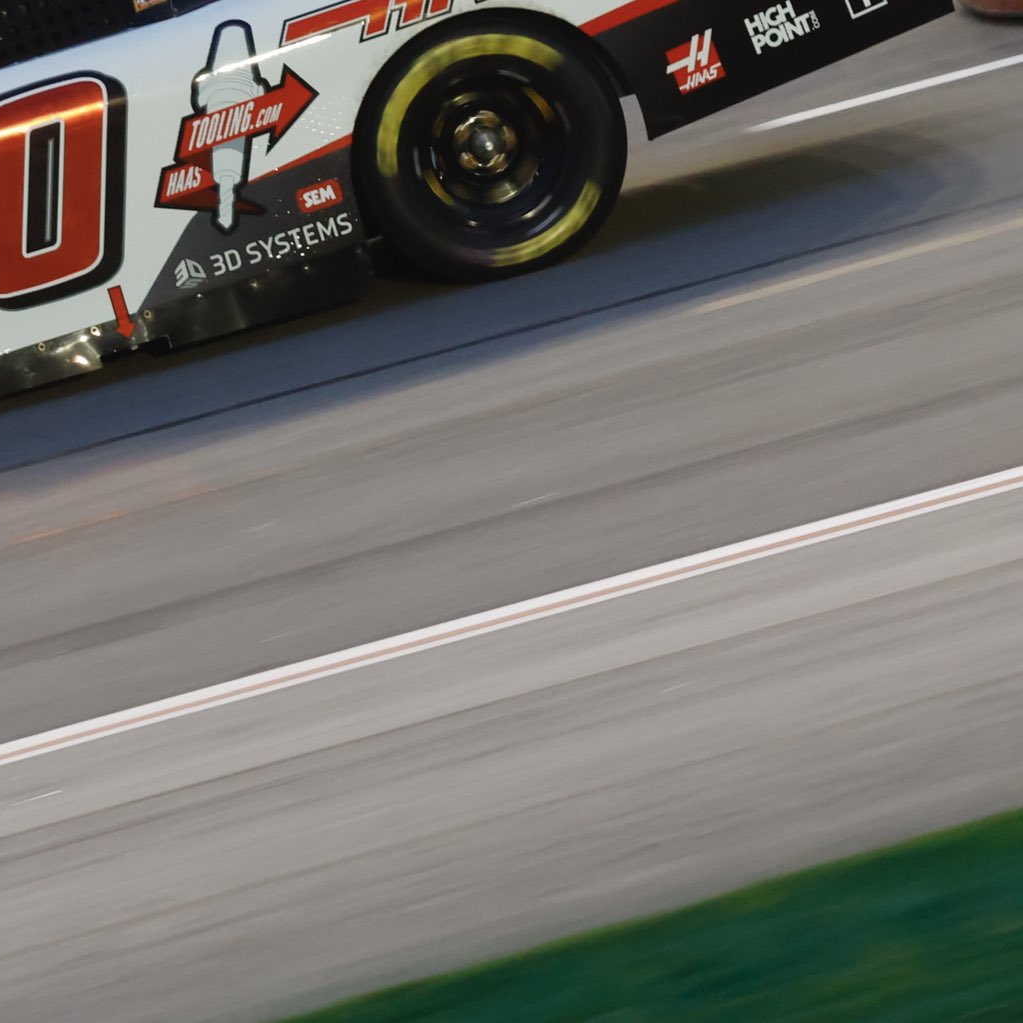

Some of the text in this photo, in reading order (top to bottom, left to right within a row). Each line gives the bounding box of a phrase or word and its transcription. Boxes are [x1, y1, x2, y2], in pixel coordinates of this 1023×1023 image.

[744, 0, 797, 37] HIGH
[751, 12, 811, 55] POINT
[679, 62, 723, 91] HAAS
[166, 166, 203, 197] HAAS
[302, 185, 336, 208] SEM
[209, 212, 354, 277] 3D SYSTEMS
